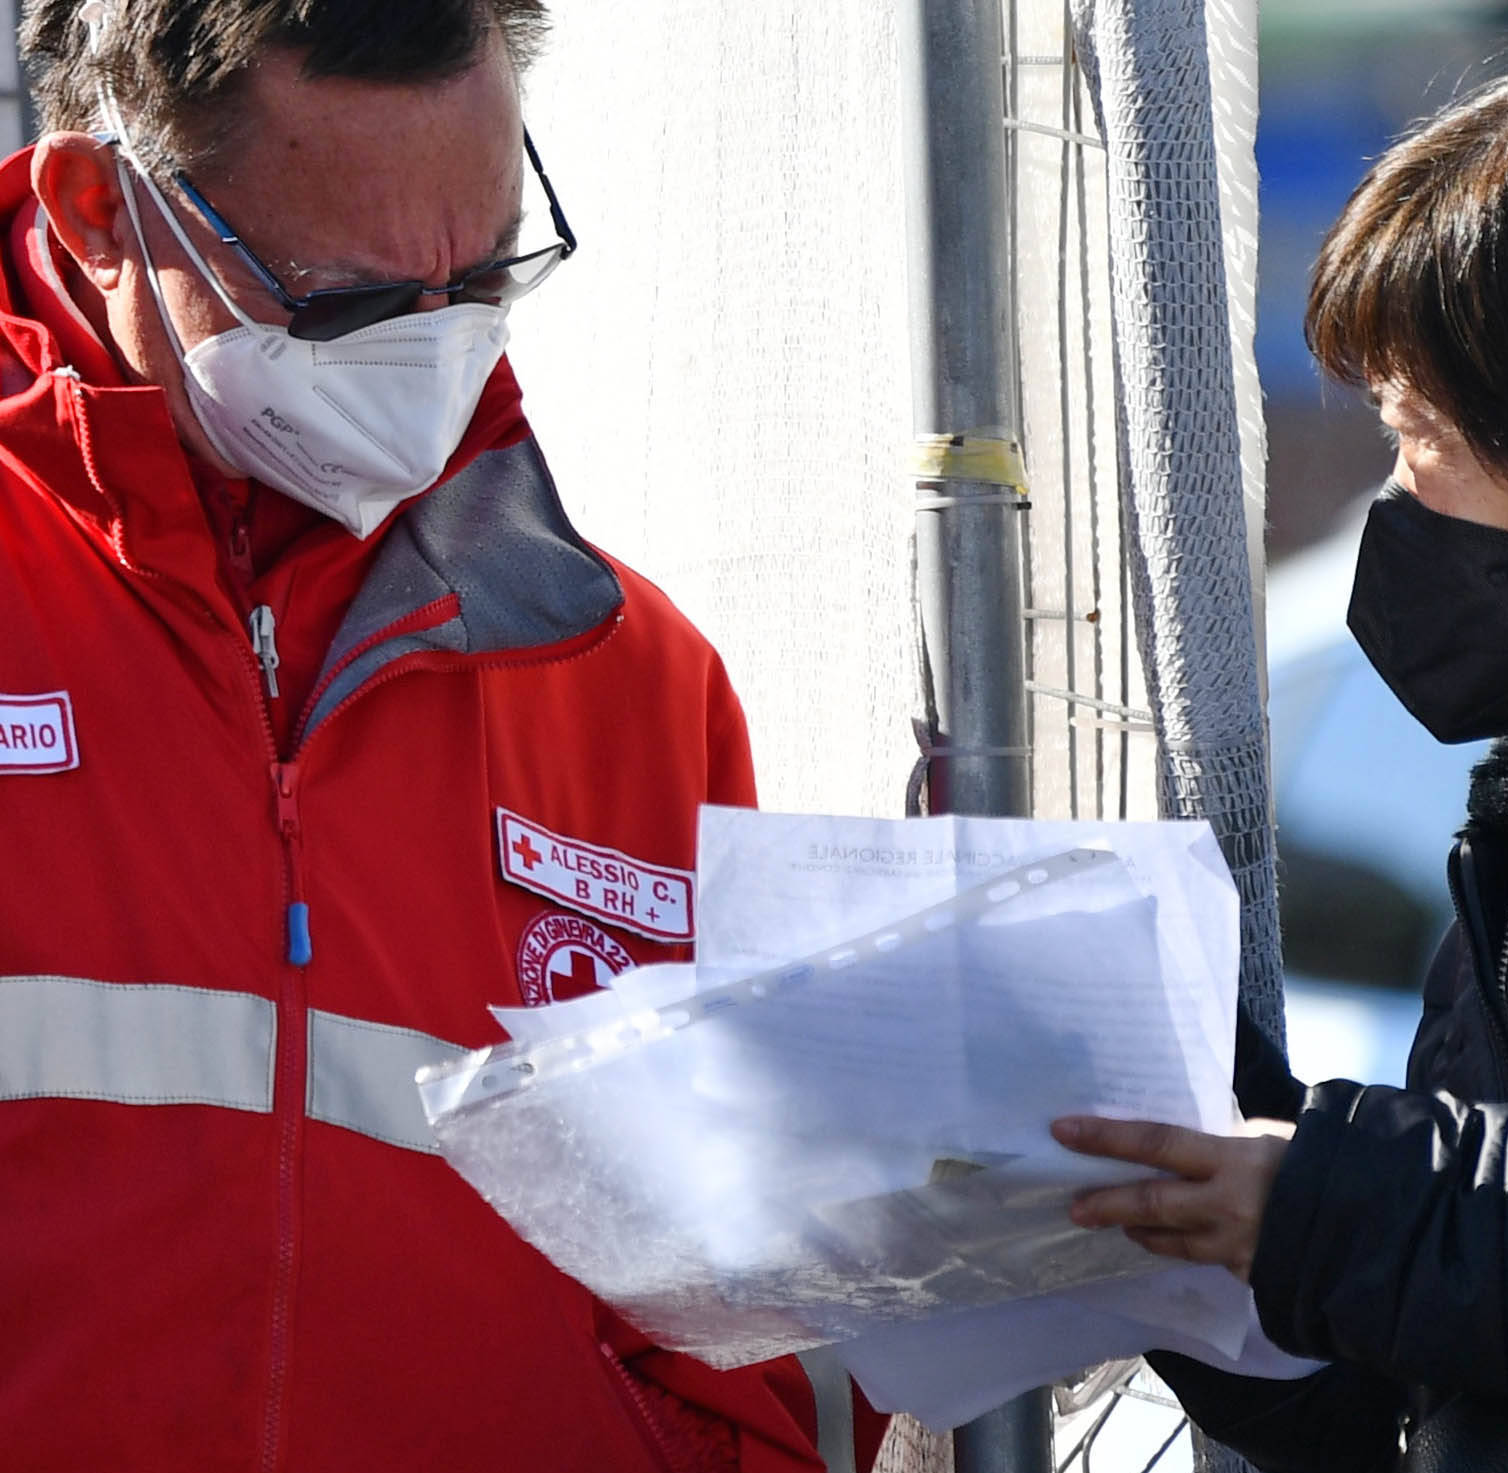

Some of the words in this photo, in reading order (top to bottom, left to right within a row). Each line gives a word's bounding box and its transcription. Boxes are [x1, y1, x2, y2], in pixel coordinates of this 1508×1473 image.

[550, 844, 640, 891] ALESSIO
[651, 880, 676, 905] C.
[575, 878, 591, 899] B
[602, 887, 635, 916] RH
